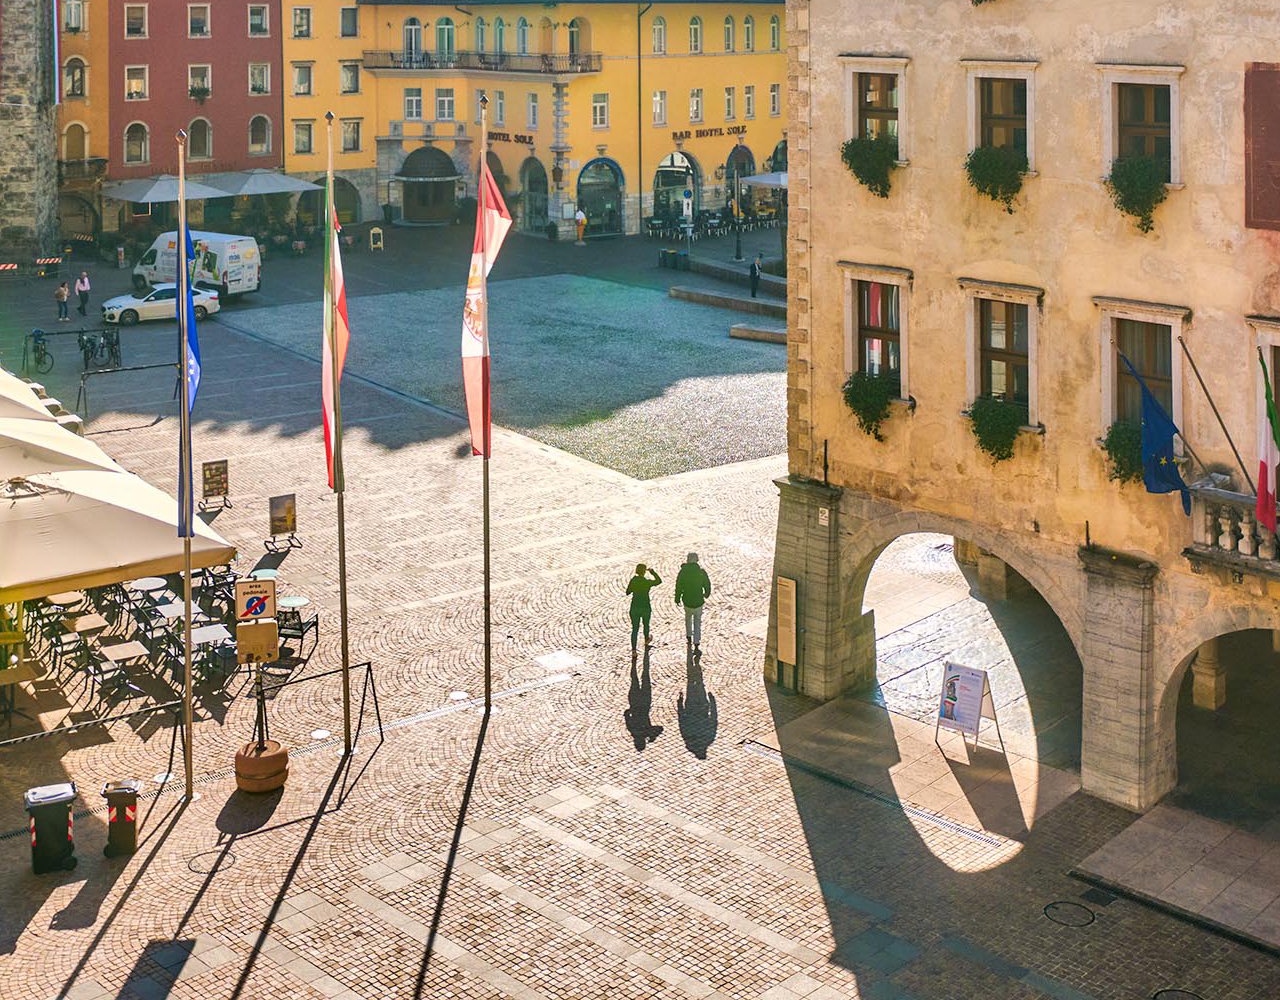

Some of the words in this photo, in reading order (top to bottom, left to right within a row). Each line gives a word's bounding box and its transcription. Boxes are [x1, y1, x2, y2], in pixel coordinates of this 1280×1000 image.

[487, 131, 512, 143] HOTEL
[513, 134, 534, 145] SOLE
[672, 130, 692, 140] BAR
[695, 127, 725, 138] HOTEL
[727, 125, 747, 135] SOLE
